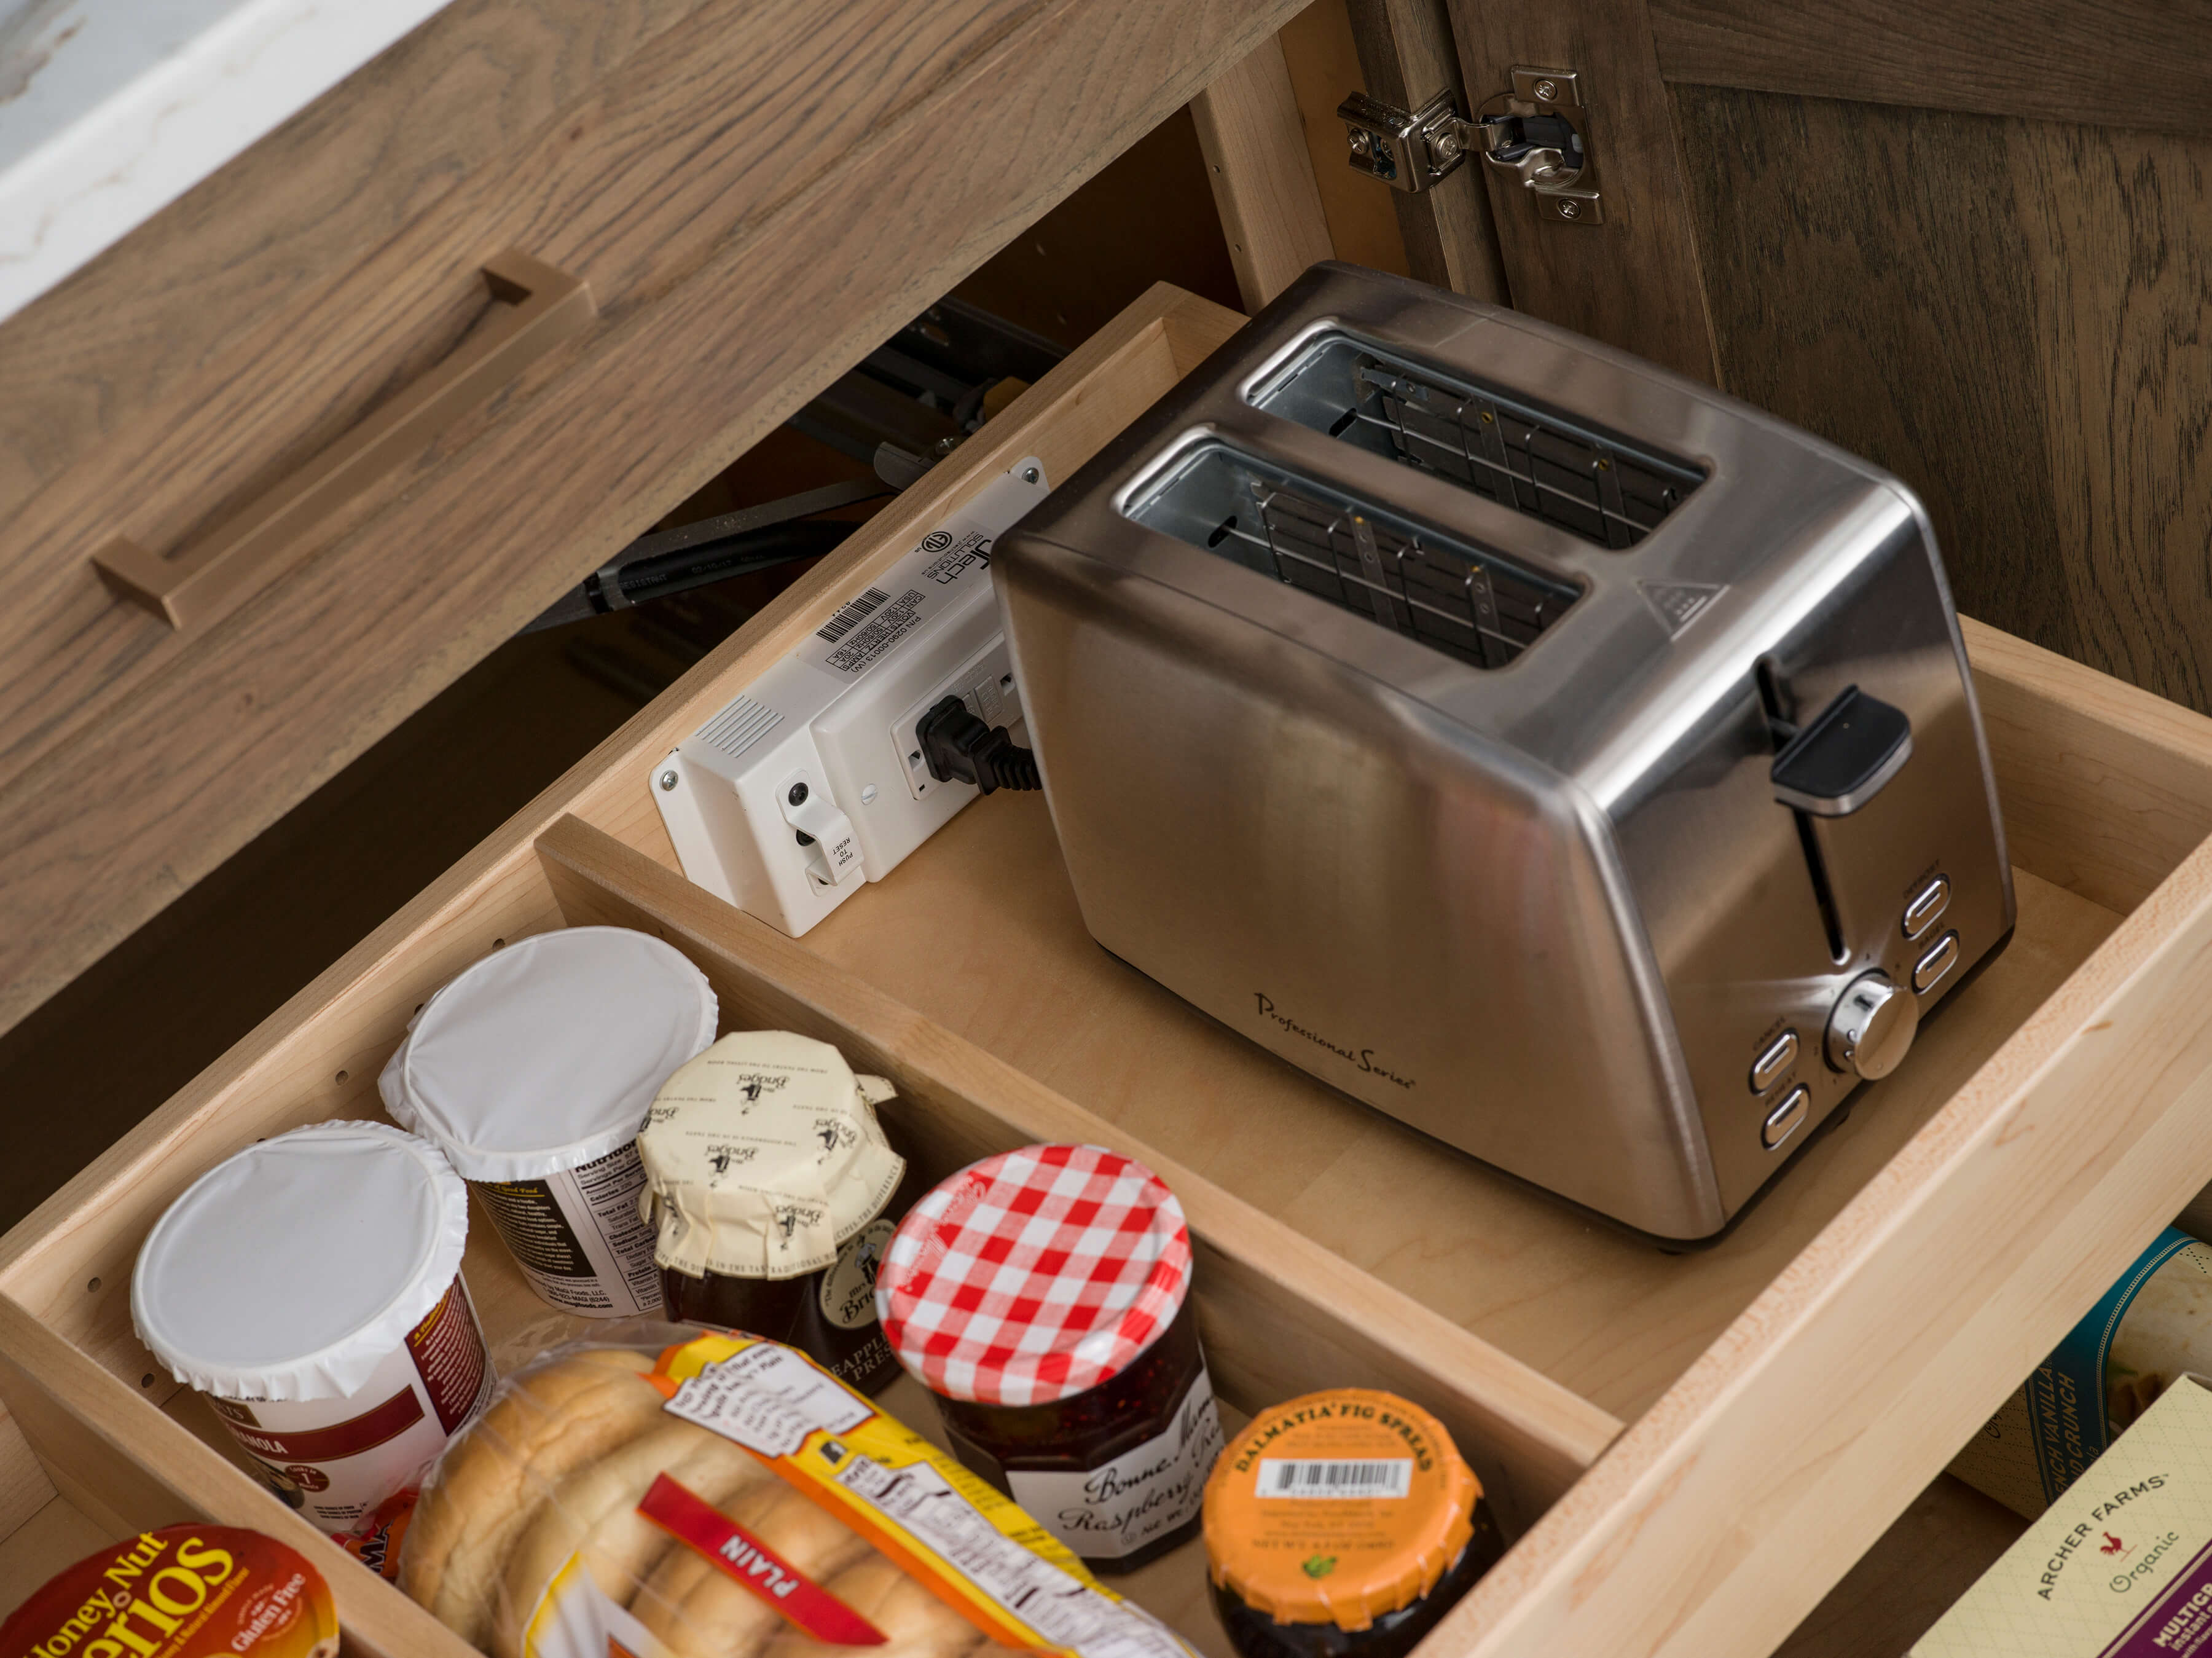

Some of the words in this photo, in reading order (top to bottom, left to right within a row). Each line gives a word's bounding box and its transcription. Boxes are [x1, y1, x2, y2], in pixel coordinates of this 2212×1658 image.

[927, 533, 983, 580] SOLUTIONS
[898, 591, 915, 605] USA
[905, 595, 922, 608] CAN
[880, 605, 897, 619] 120V
[886, 609, 903, 623] 120V
[888, 611, 913, 631] VOLTS
[905, 615, 920, 629] P/N
[849, 623, 876, 645] 50/60Hz
[855, 627, 882, 649] 50/60Hz
[863, 631, 888, 651] HERTZ
[838, 650, 853, 662] 20A
[841, 651, 863, 670] AMPS
[850, 659, 866, 673] (W)
[832, 837, 850, 855] RESET
[838, 852, 853, 866] PUSH
[1254, 992, 1355, 1061] Professional
[1357, 1049, 1416, 1089] Series
[735, 1072, 788, 1088] Bridges
[577, 1166, 605, 1179] Serving
[586, 1182, 611, 1195] Amount
[590, 1188, 618, 1202] Calories
[620, 1181, 632, 1190] 220
[597, 1208, 615, 1217] Total
[608, 1208, 637, 1222] Saturated
[612, 1235, 638, 1247] Sodium
[616, 1245, 633, 1255] Total
[628, 1265, 651, 1277] Protein
[632, 1276, 653, 1286] Vitamin
[2037, 1366, 2060, 1442] VANILLA
[2058, 1372, 2077, 1460] CRUNCH
[1236, 1405, 1333, 1472] DALMATIA
[1341, 1405, 1375, 1418] FIG
[1381, 1412, 1433, 1472] SPREAD
[1084, 1456, 1169, 1504] Bonne
[1058, 1469, 1193, 1531] Raspberry
[2037, 1522, 2093, 1600] ARCHER
[2092, 1474, 2166, 1522] FARMS
[103, 1531, 168, 1589] Nut
[718, 1533, 799, 1599] PLAIN
[2109, 1530, 2179, 1593] Organic
[231, 1599, 280, 1651] Gluten
[272, 1573, 307, 1607] Free
